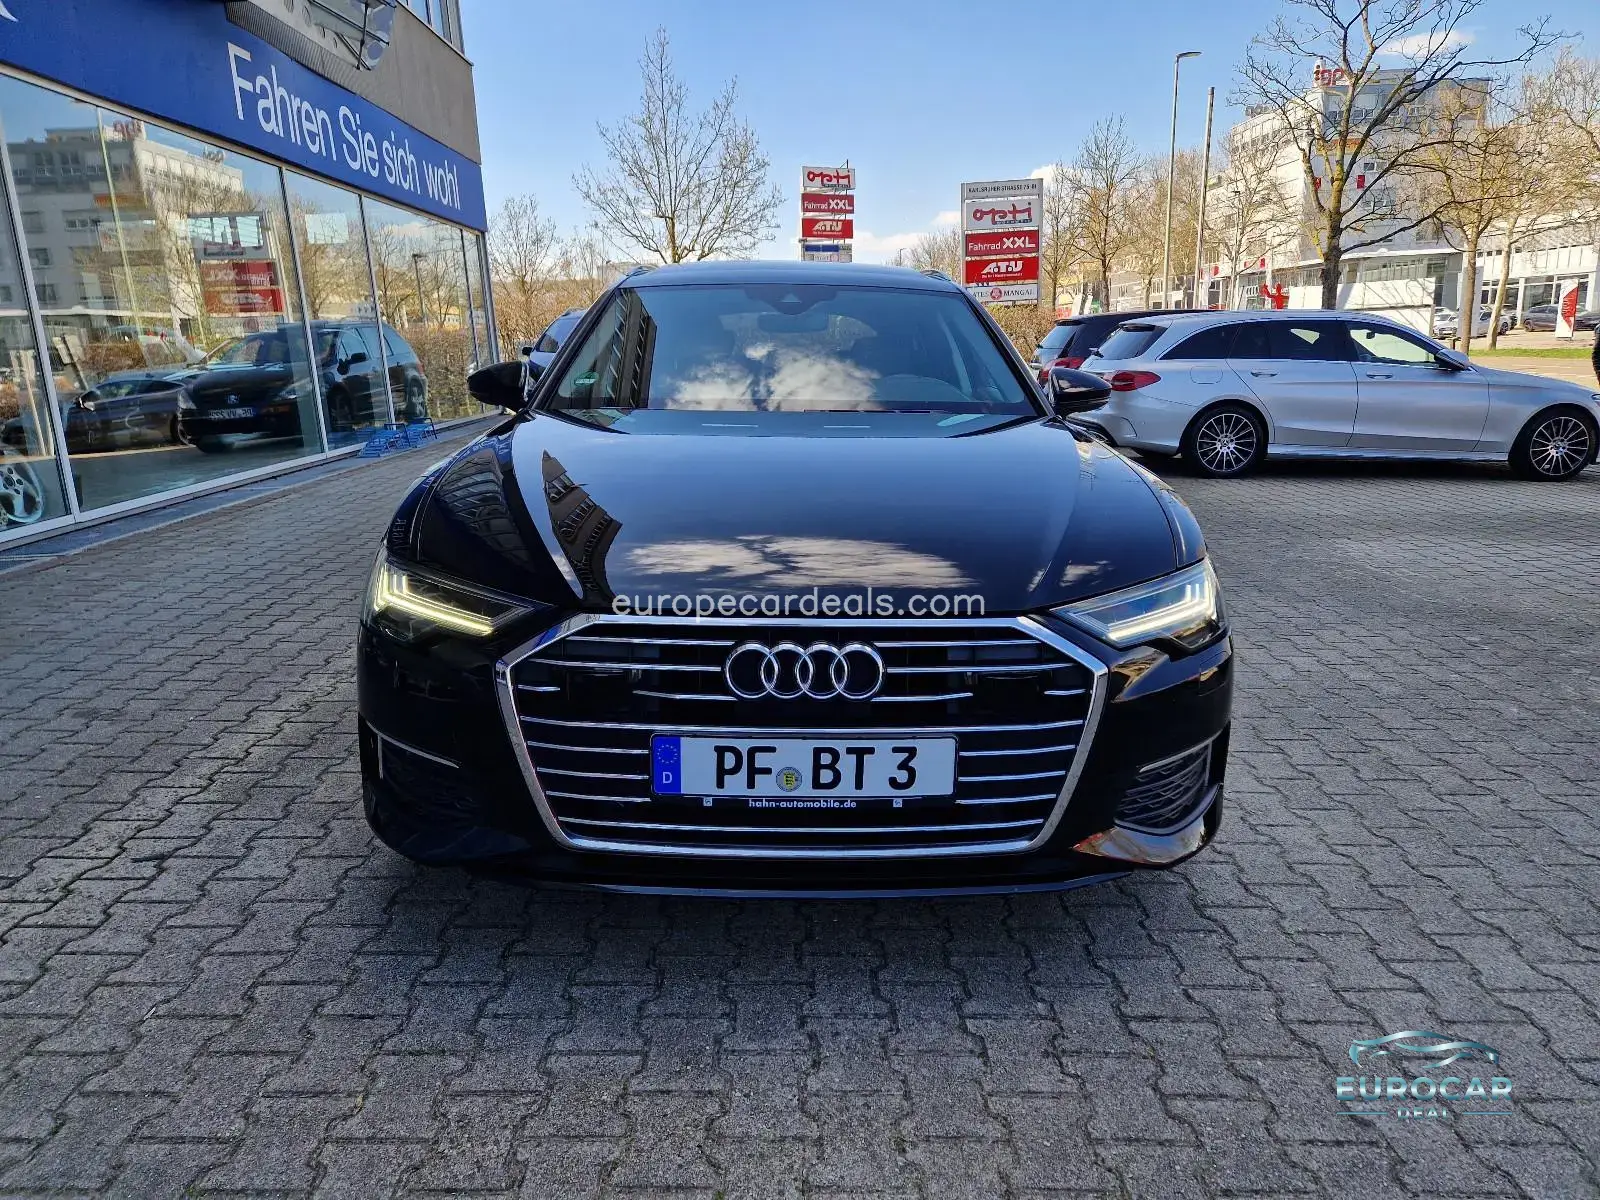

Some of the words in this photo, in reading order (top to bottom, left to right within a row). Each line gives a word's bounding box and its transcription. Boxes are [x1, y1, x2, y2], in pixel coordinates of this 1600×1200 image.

[228, 42, 337, 161] Fahren
[338, 105, 380, 178] Sie
[382, 130, 421, 195] sich
[423, 160, 461, 211] wohl
[804, 201, 829, 210] Fahrrad
[829, 198, 853, 210] XXL
[968, 241, 1001, 251] Fahrrad
[1003, 236, 1036, 249] XXL
[662, 771, 673, 784] D
[714, 745, 777, 789] PF
[811, 746, 876, 790] BT
[888, 746, 918, 791] 3
[748, 798, 857, 809] hahn-automobile.de
